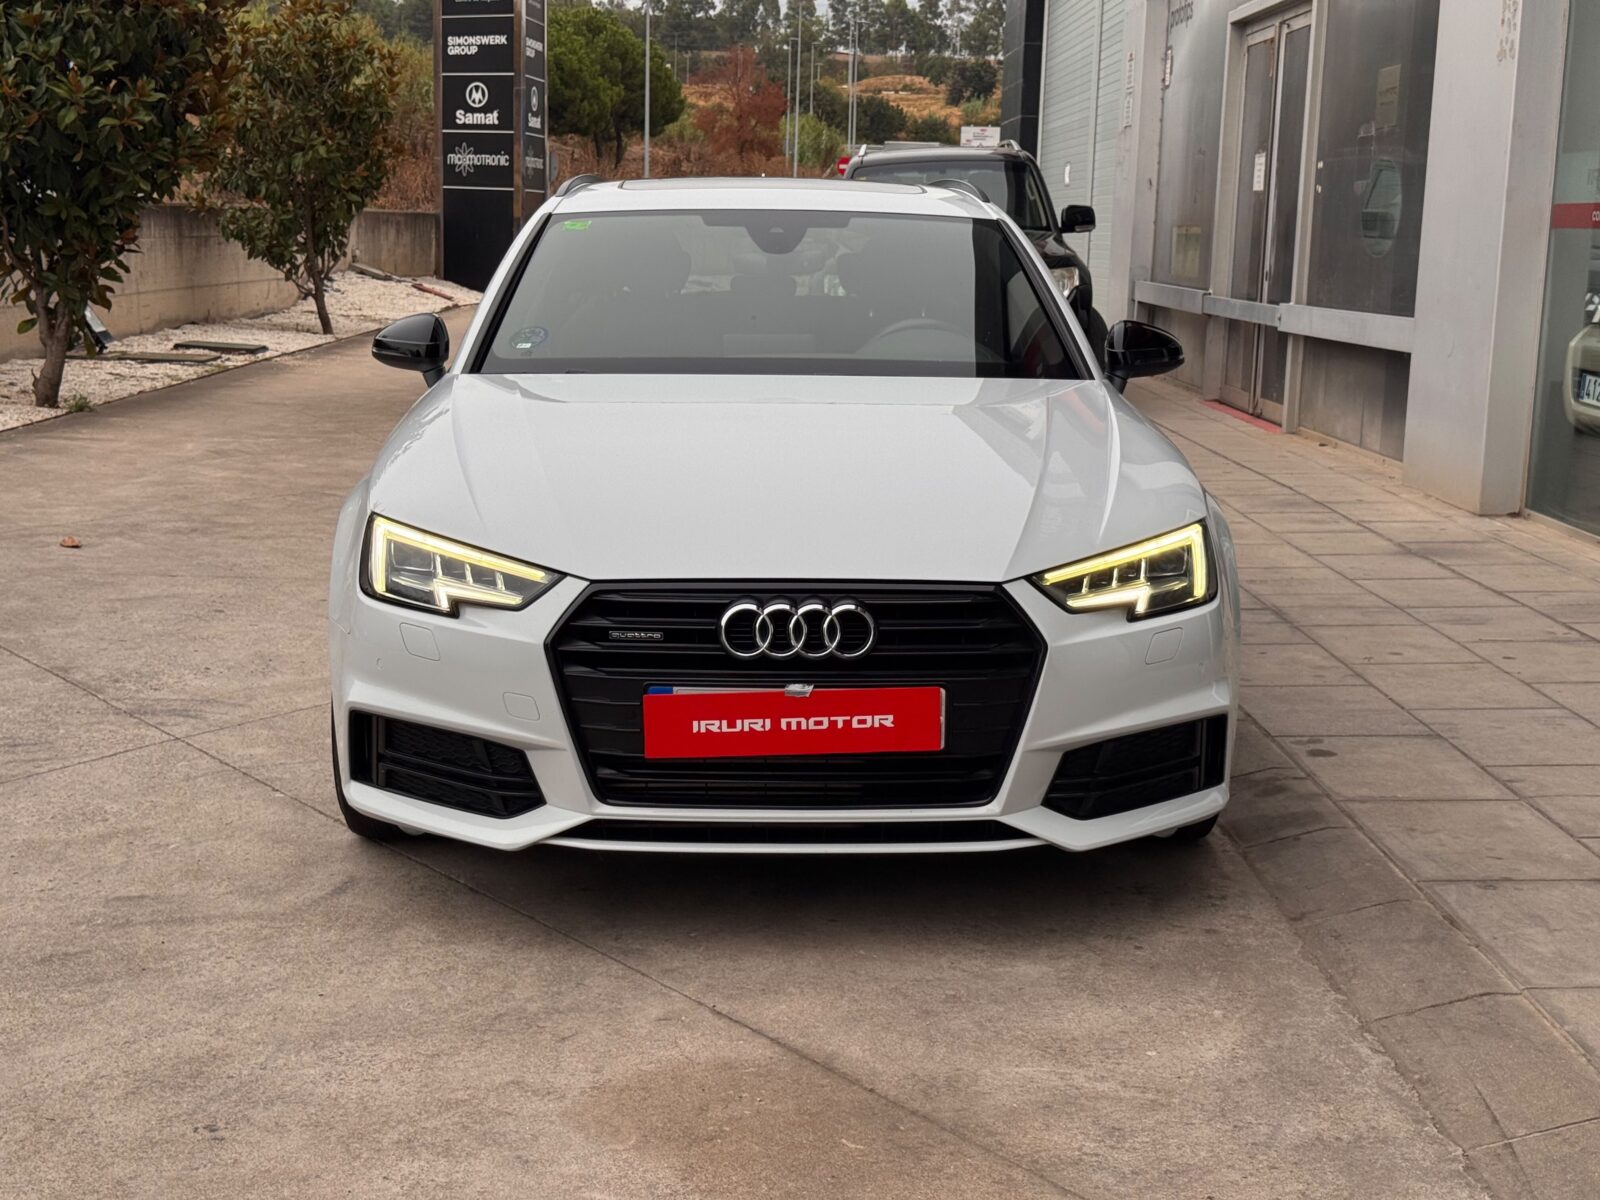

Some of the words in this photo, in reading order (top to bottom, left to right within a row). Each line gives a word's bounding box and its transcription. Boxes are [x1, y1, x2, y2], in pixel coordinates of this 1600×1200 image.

[447, 34, 508, 46] SIMONSWERK
[447, 45, 478, 56] GROUP
[455, 109, 499, 125] Samat
[610, 631, 662, 640] quattro
[692, 719, 771, 734] IRURI
[780, 714, 895, 731] MOTOR
